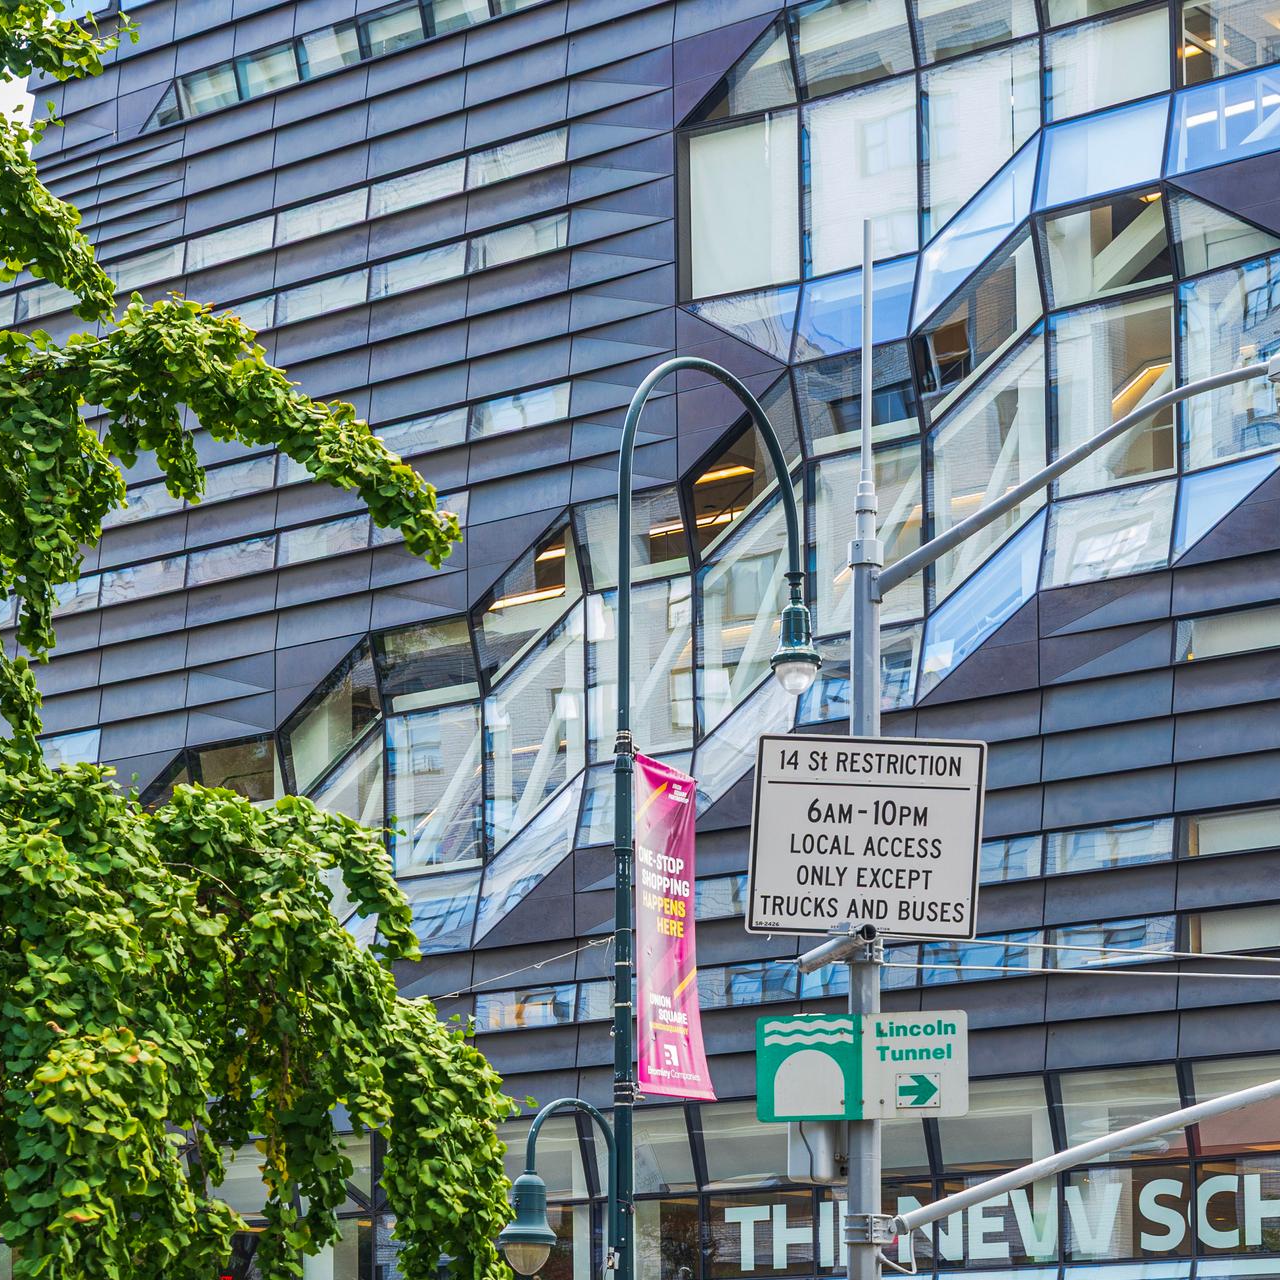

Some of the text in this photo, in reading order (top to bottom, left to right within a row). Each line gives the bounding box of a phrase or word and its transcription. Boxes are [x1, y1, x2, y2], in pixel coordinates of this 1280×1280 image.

[780, 749, 962, 777] 14 St RESTRICTION
[807, 798, 928, 827] 6AM-10PM
[790, 833, 942, 859] LOCAL ACCESS
[638, 845, 684, 875] ONE-STOP
[641, 869, 690, 898] SHOPPING
[796, 865, 932, 890] ONLY EXCEPT
[642, 891, 686, 918] HAPPENS
[760, 895, 964, 923] TRUCKS AND BUSES
[656, 915, 684, 938] HERE
[649, 992, 671, 1009] UNION
[658, 1008, 688, 1025] SQUARE
[875, 1019, 956, 1037] Lincoln
[876, 1043, 952, 1061] Tunnel
[898, 1184, 1122, 1263] NEW
